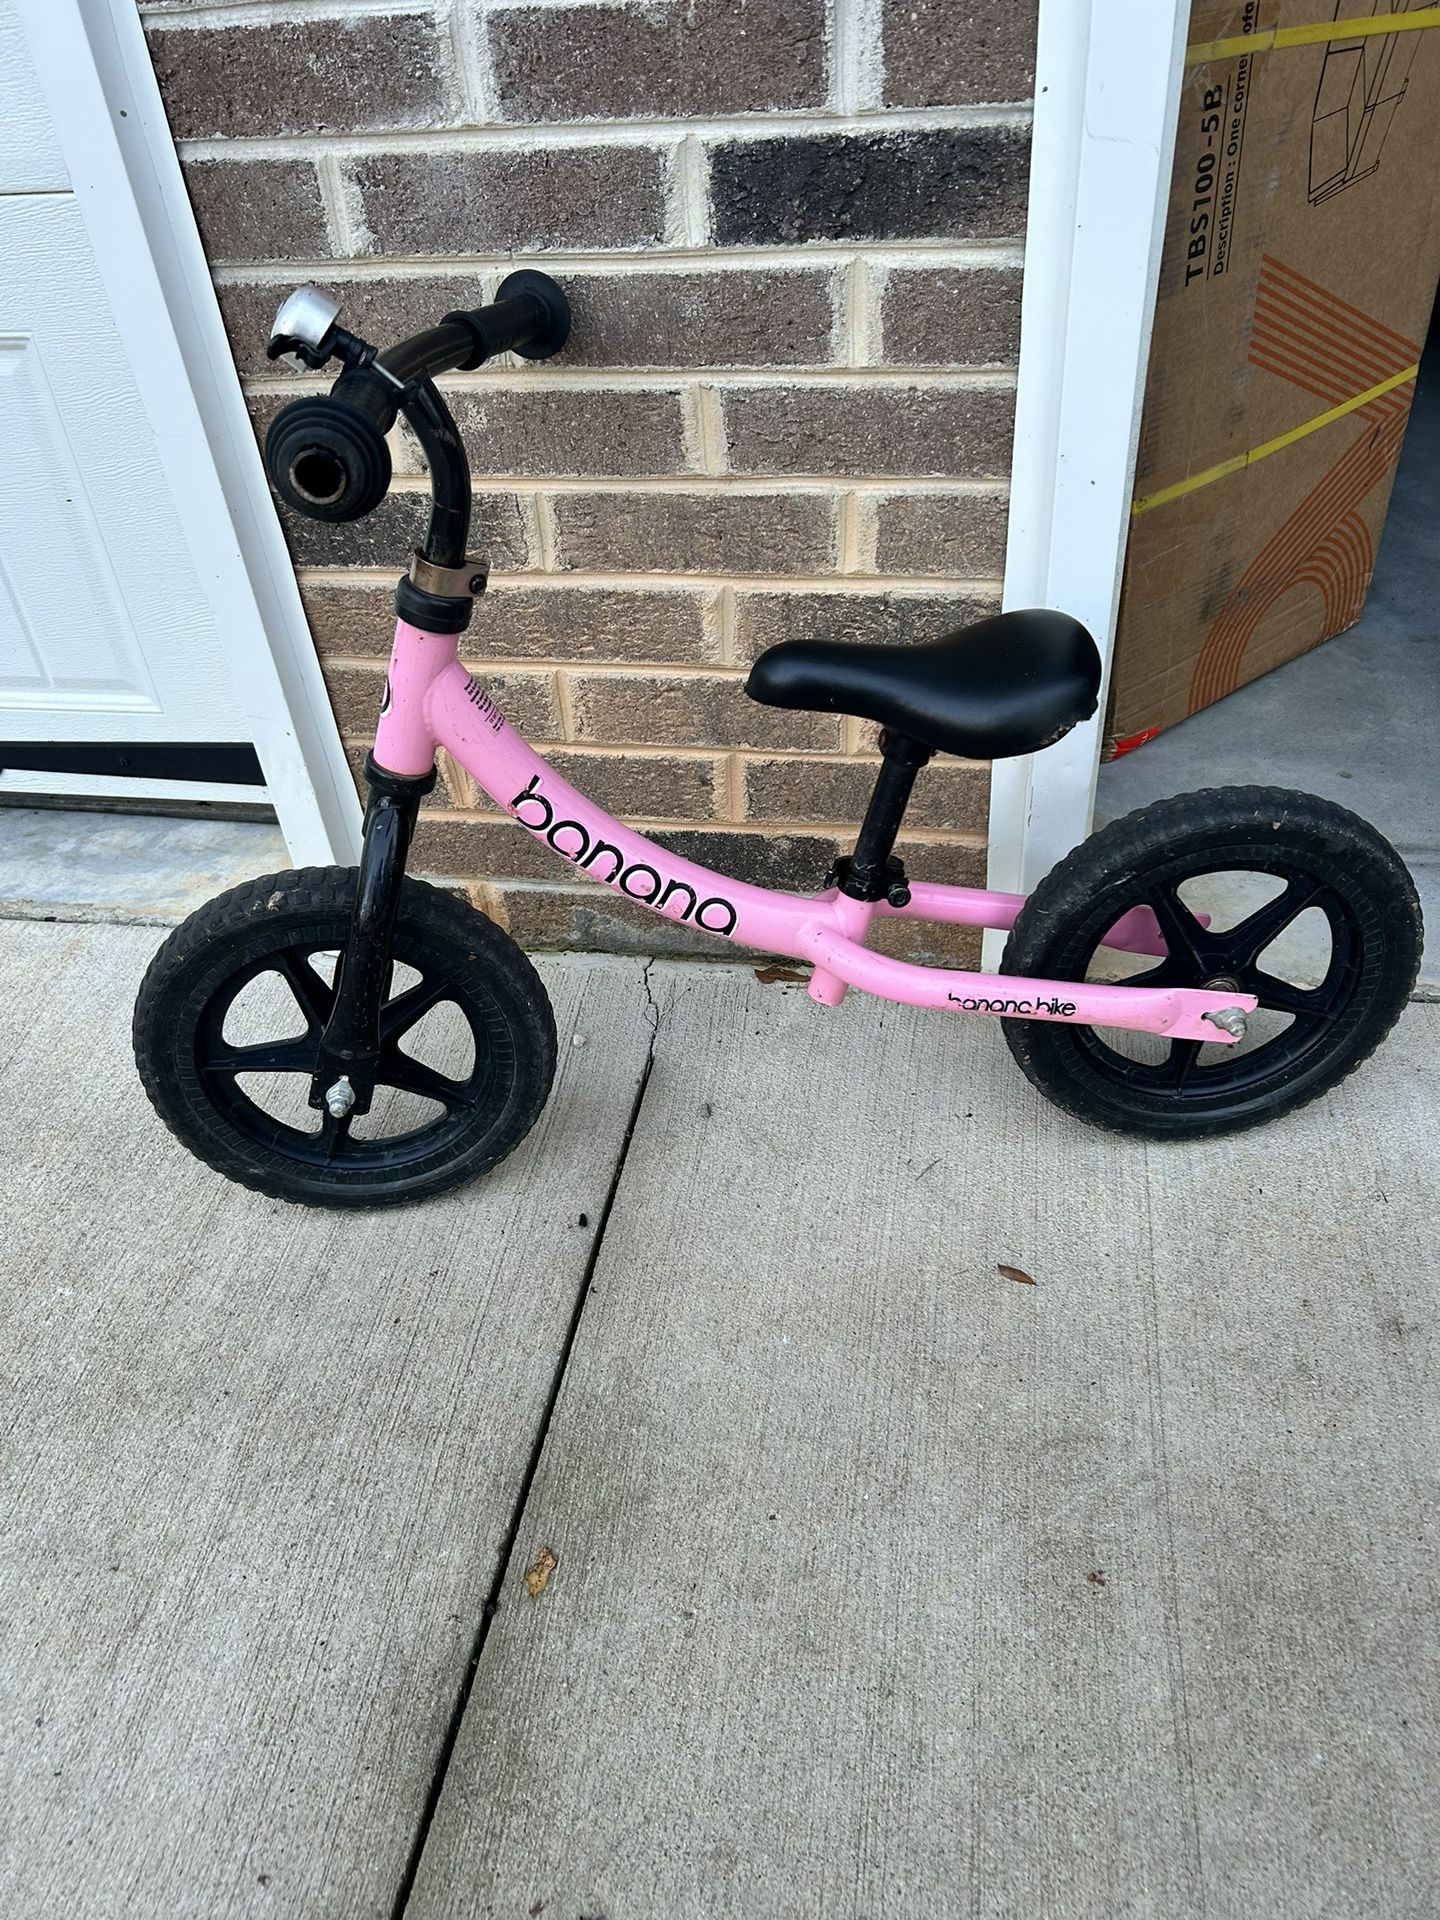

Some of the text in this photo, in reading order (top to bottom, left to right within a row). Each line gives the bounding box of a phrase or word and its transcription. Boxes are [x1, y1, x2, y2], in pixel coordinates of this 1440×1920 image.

[1213, 171, 1235, 276] Description
[1226, 118, 1241, 157] One
[1242, 1, 1255, 34] ofa
[511, 774, 738, 937] banana
